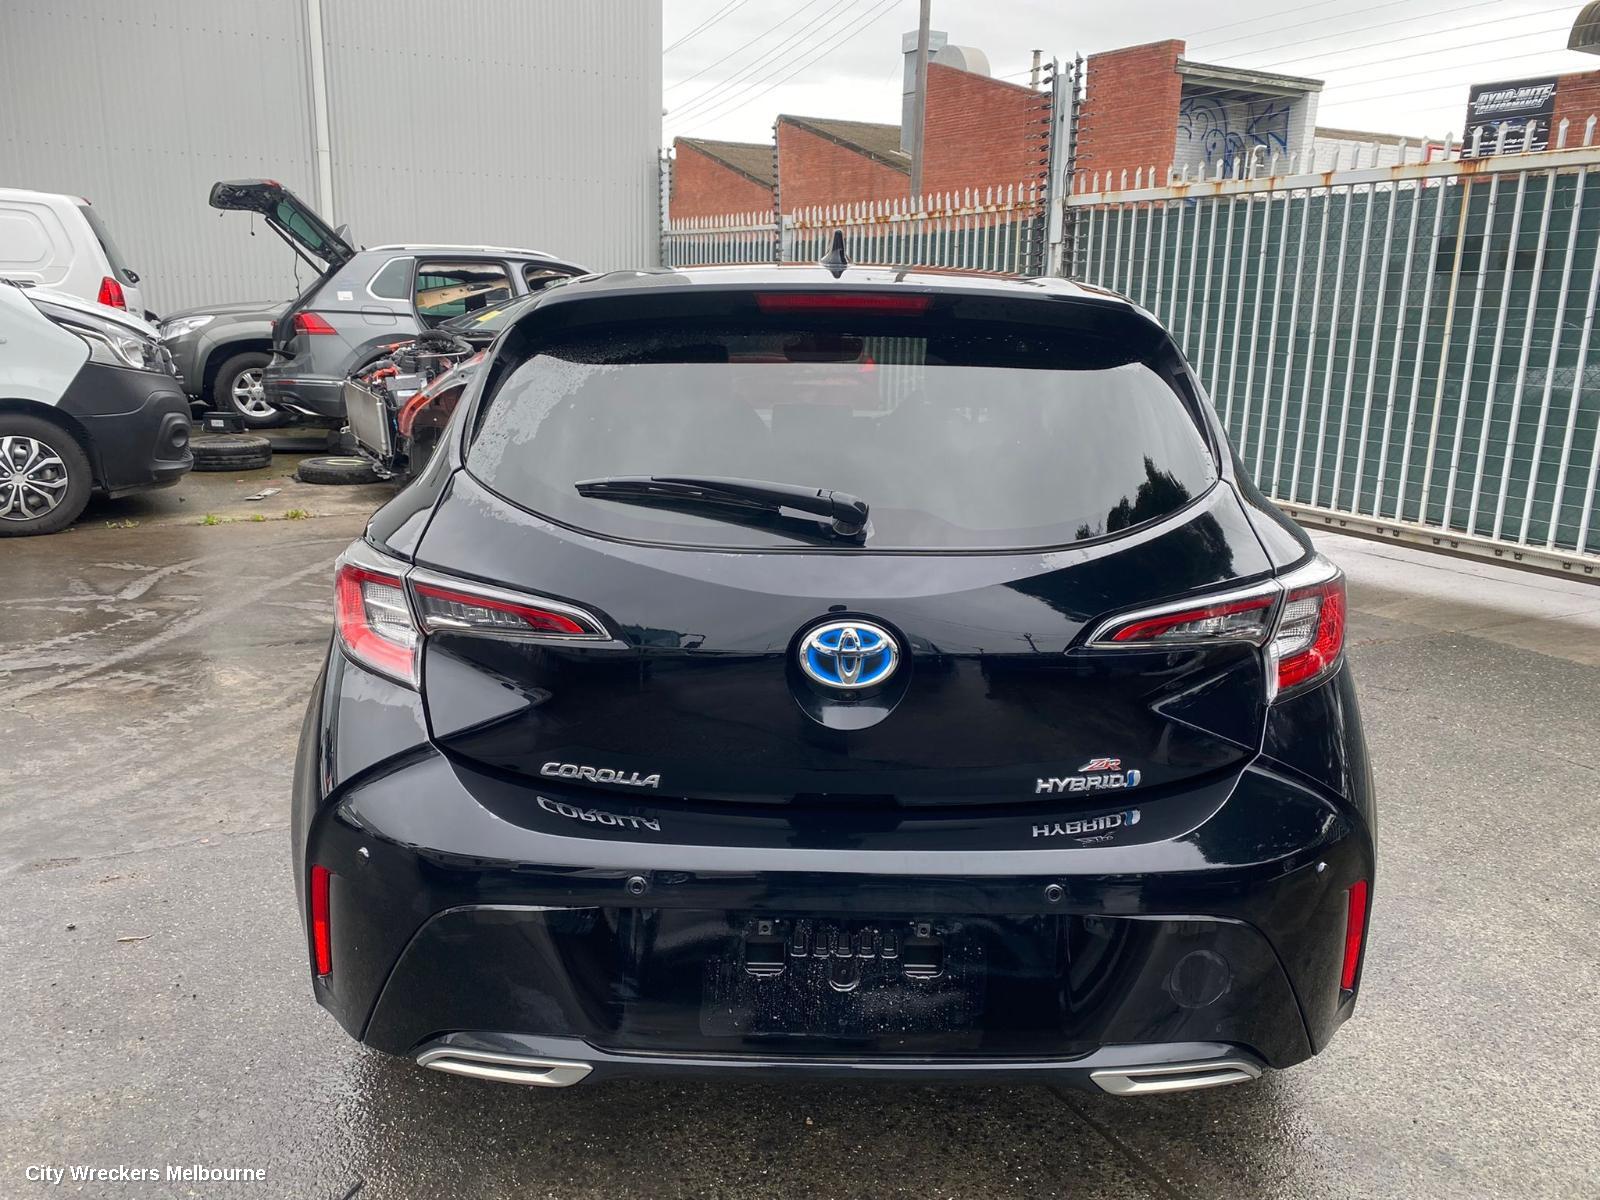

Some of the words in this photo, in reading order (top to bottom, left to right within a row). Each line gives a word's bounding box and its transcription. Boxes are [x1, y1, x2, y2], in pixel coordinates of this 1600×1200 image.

[1476, 86, 1552, 106] DYNO-MITE
[1078, 758, 1121, 772] ZR
[540, 762, 660, 789] COROLLA
[1035, 774, 1125, 794] HYBRID
